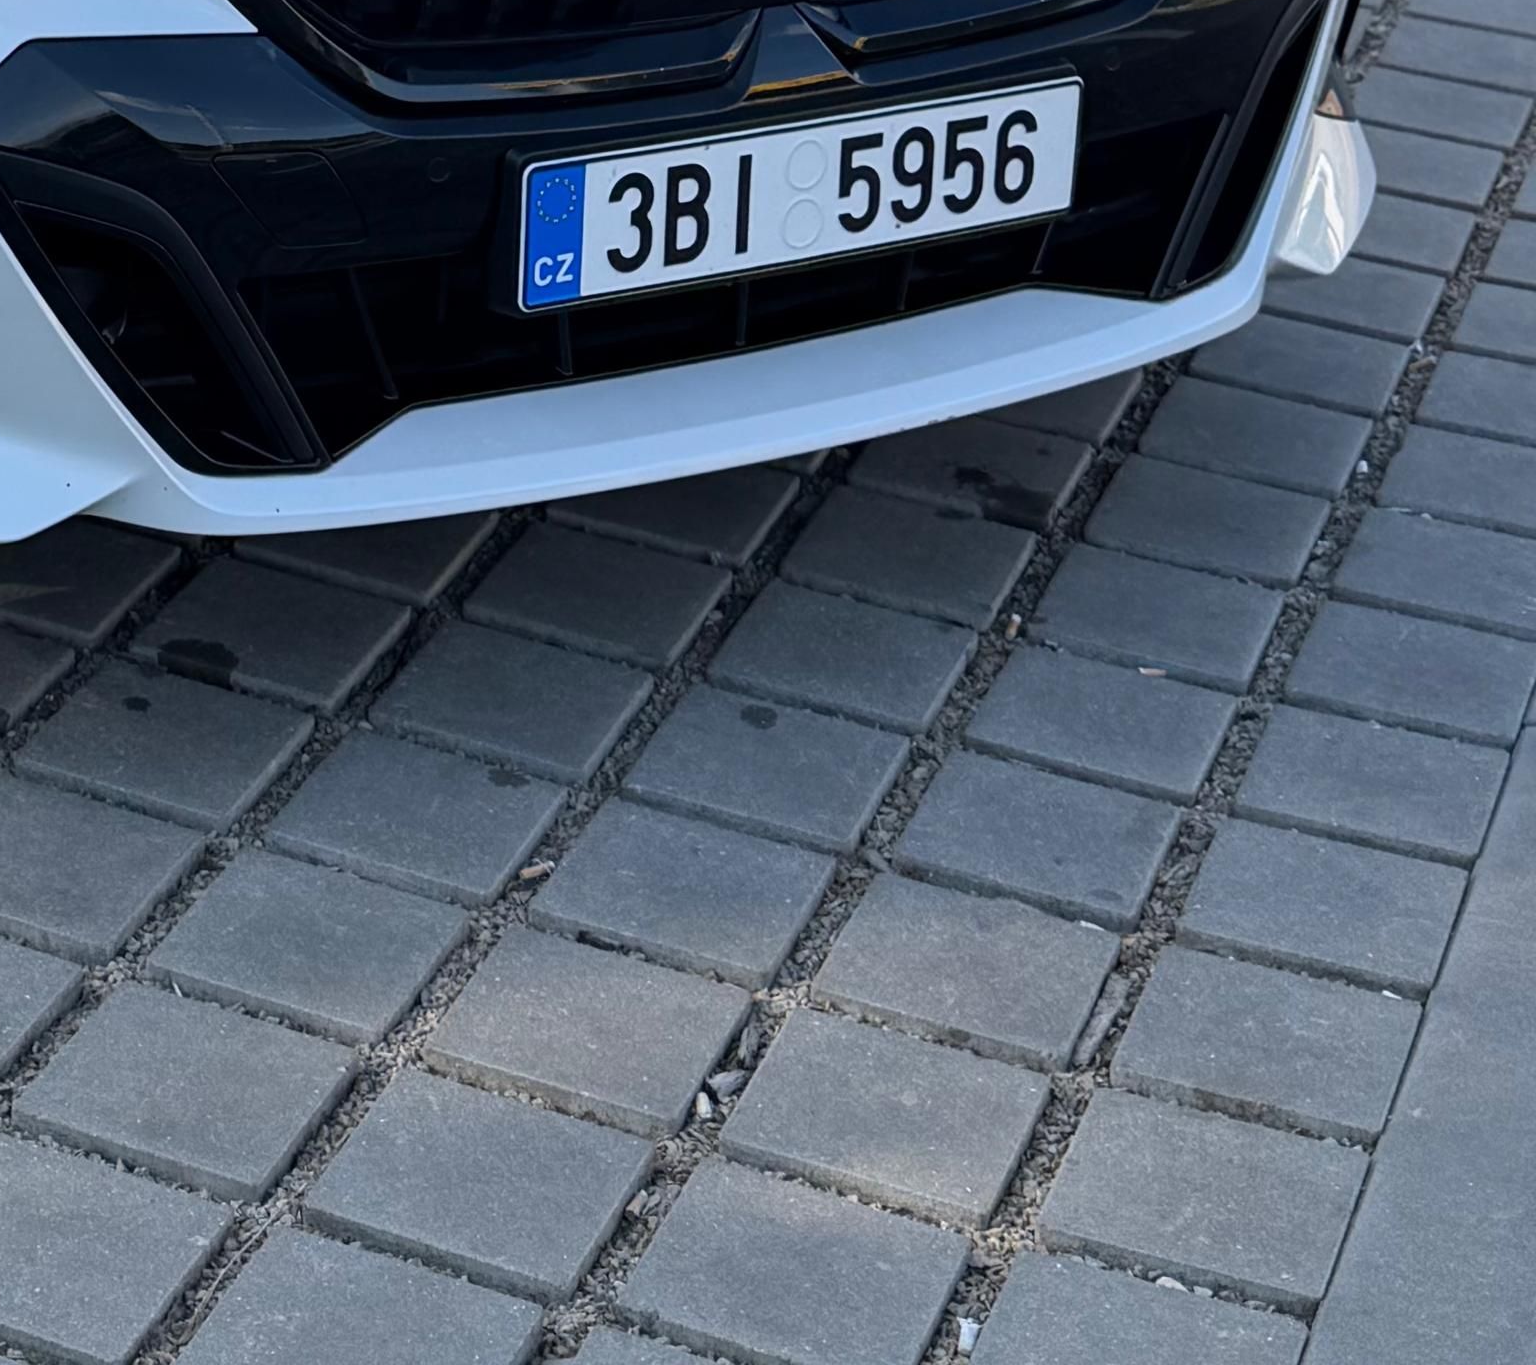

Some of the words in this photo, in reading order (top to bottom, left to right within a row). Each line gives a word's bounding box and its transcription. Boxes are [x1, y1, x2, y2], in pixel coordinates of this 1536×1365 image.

[605, 153, 754, 274] 3BI
[837, 108, 1039, 234] 5956
[533, 252, 576, 288] CZ
